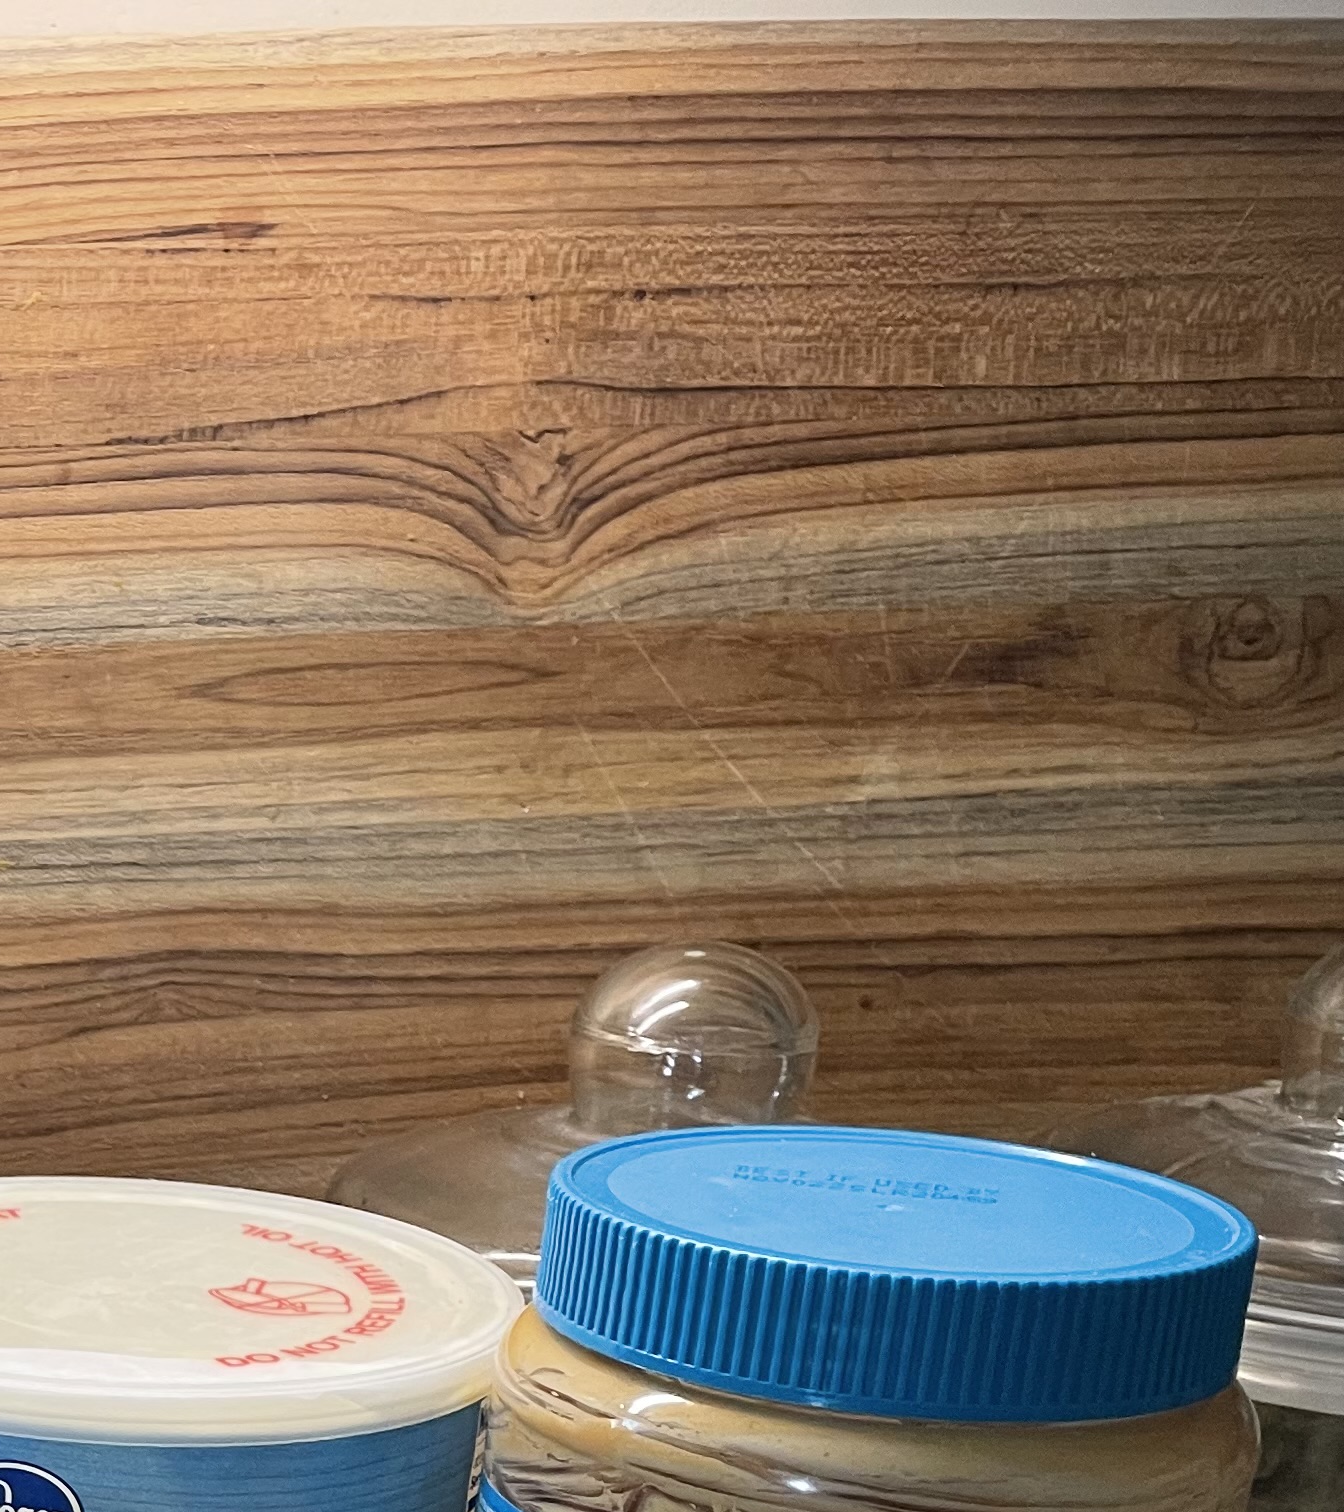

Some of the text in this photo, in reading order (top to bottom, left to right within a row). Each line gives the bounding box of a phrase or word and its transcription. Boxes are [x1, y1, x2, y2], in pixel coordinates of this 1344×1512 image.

[214, 1223, 406, 1368] DO NOT REFILL WITH HOT OIL
